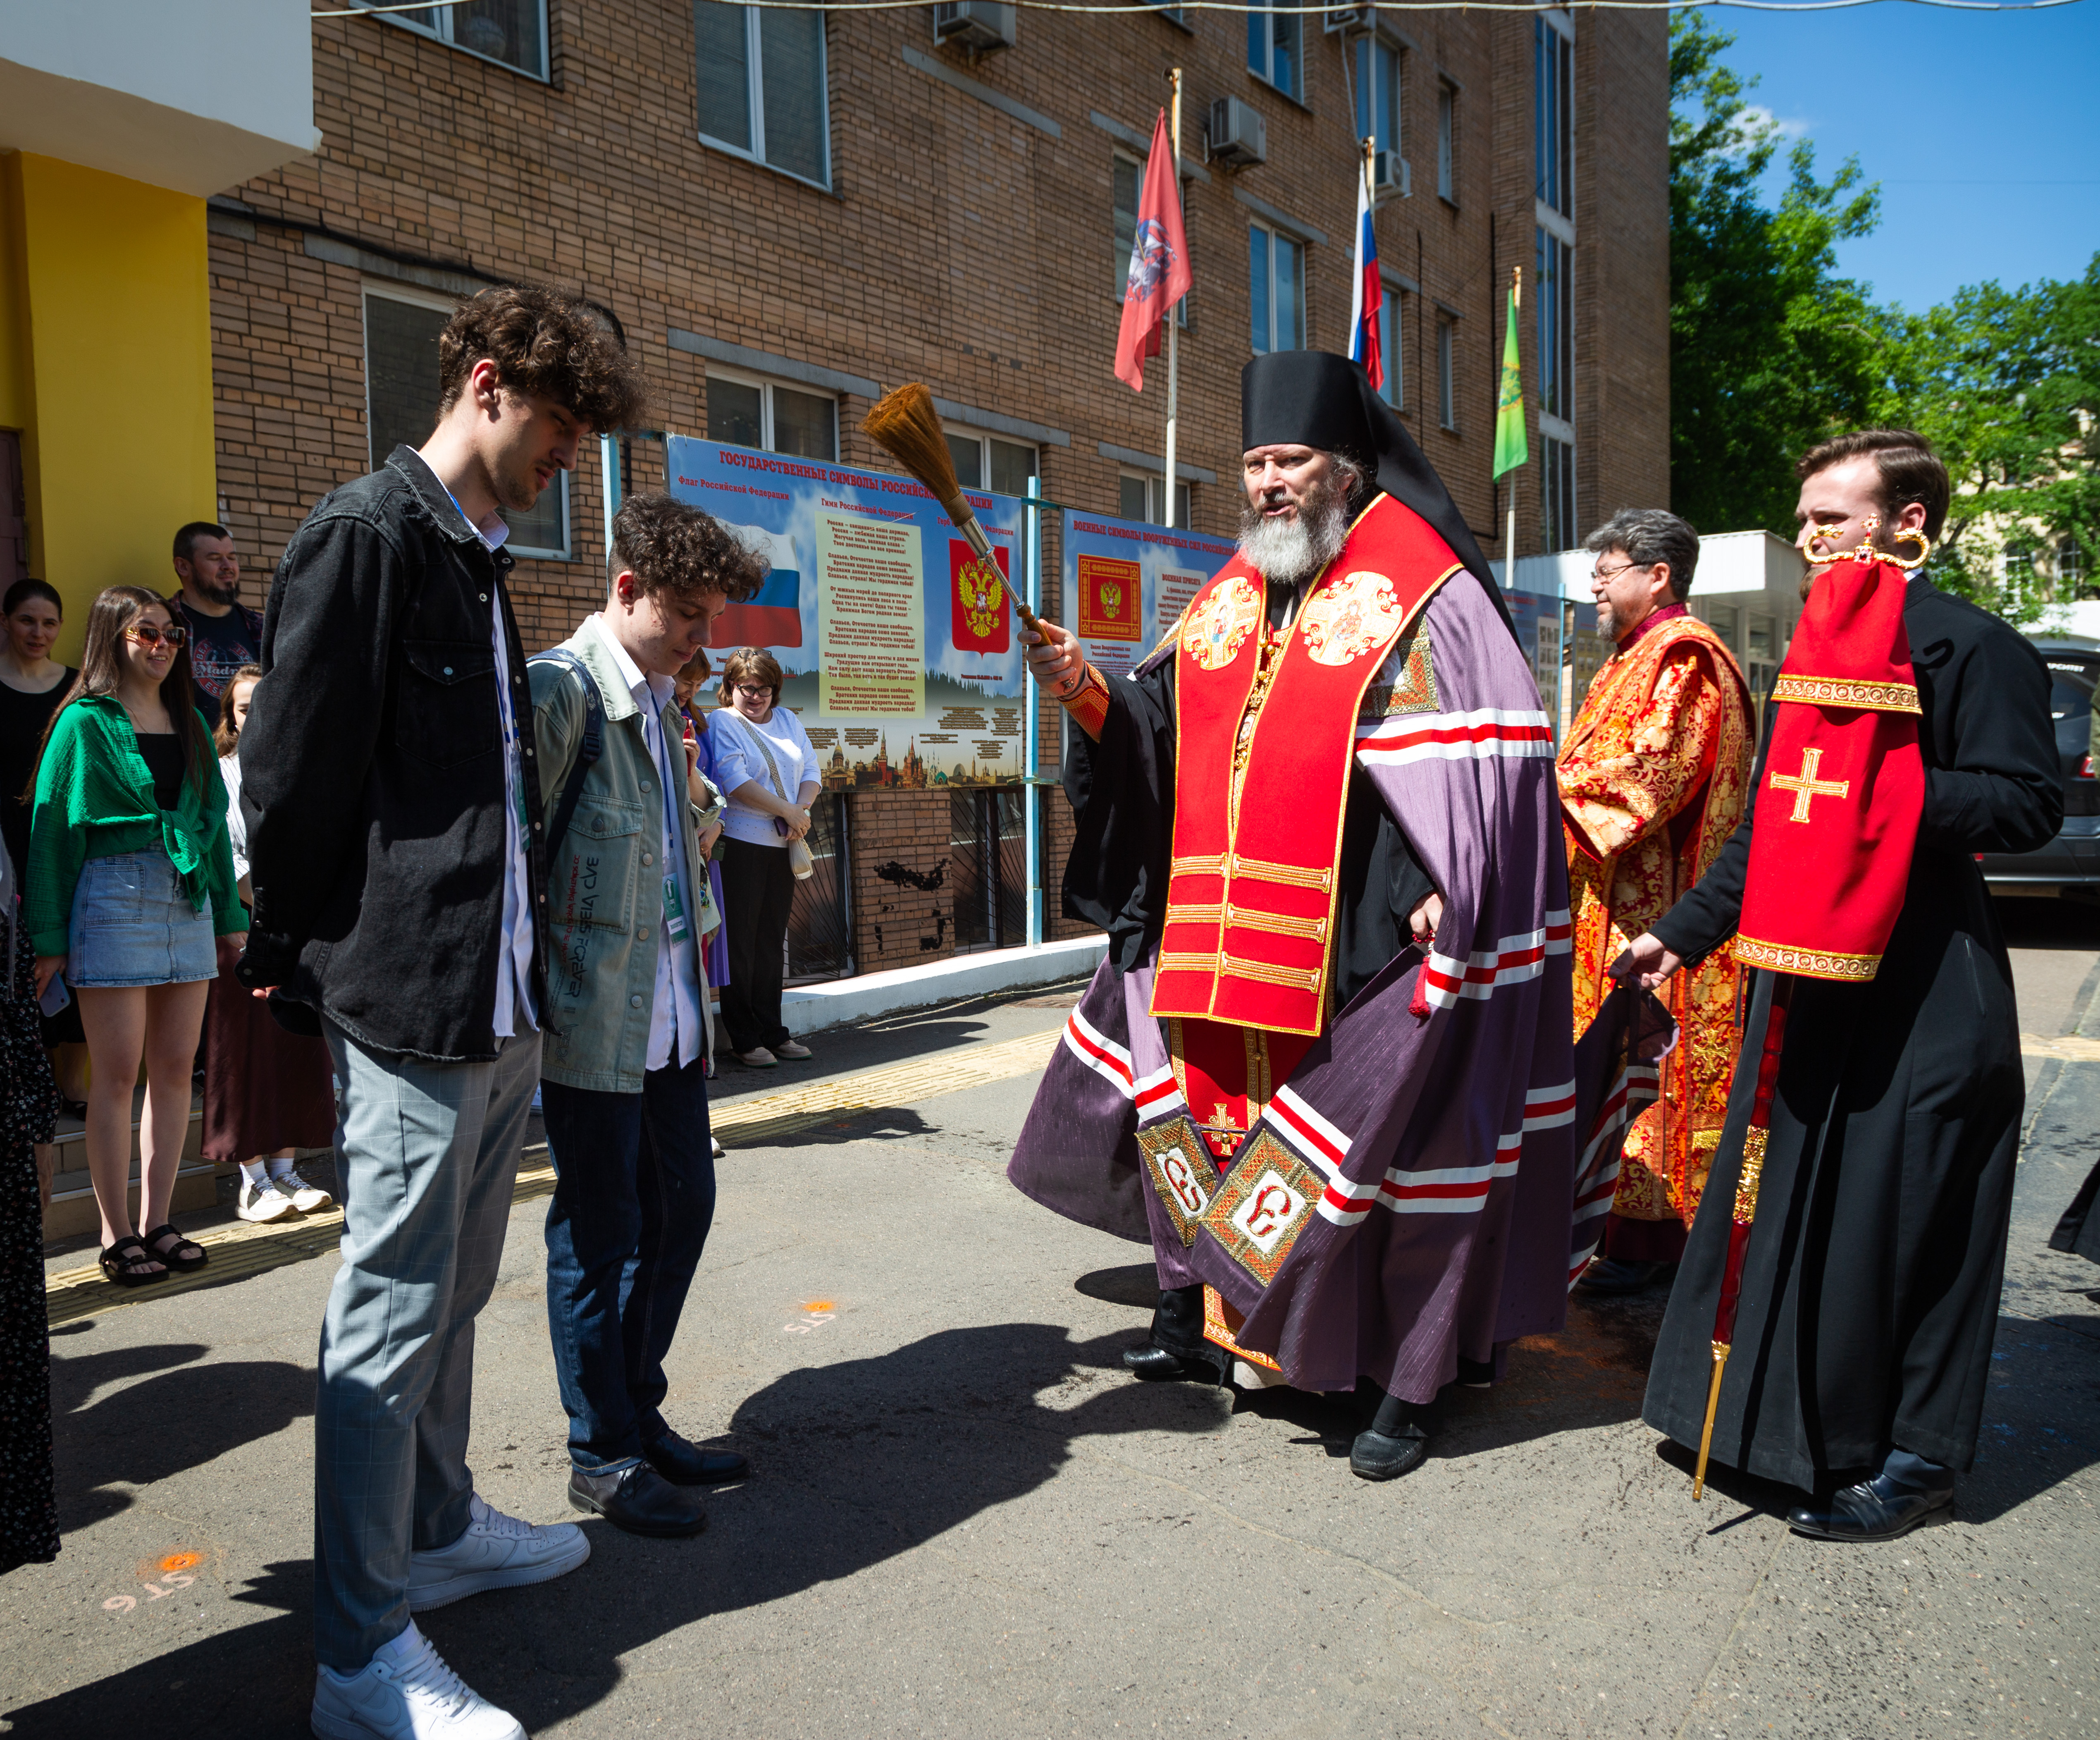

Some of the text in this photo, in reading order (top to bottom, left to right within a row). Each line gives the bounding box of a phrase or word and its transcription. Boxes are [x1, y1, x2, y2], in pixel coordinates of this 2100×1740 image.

[719, 450, 827, 480] ГОСУДАРСТВЕННЫЕ
[829, 471, 878, 490] СИМВОЛЫ
[678, 475, 789, 501] Флаг Российской Федерации
[821, 498, 913, 520] Гимн Российской Федерации
[937, 516, 950, 527] Герб
[985, 524, 1014, 536] Федерации
[1074, 520, 1106, 535] ВОЕННЫЕ
[1108, 526, 1141, 540] СИМВОЛЫ
[1143, 531, 1188, 549] ВООРУЖЕННЫХ
[1189, 540, 1201, 550] СИЛ
[1162, 574, 1201, 586] ВОЕННАЯ ПРИСЯГА
[580, 856, 599, 890] BAD
[563, 937, 589, 998] FOREVER
